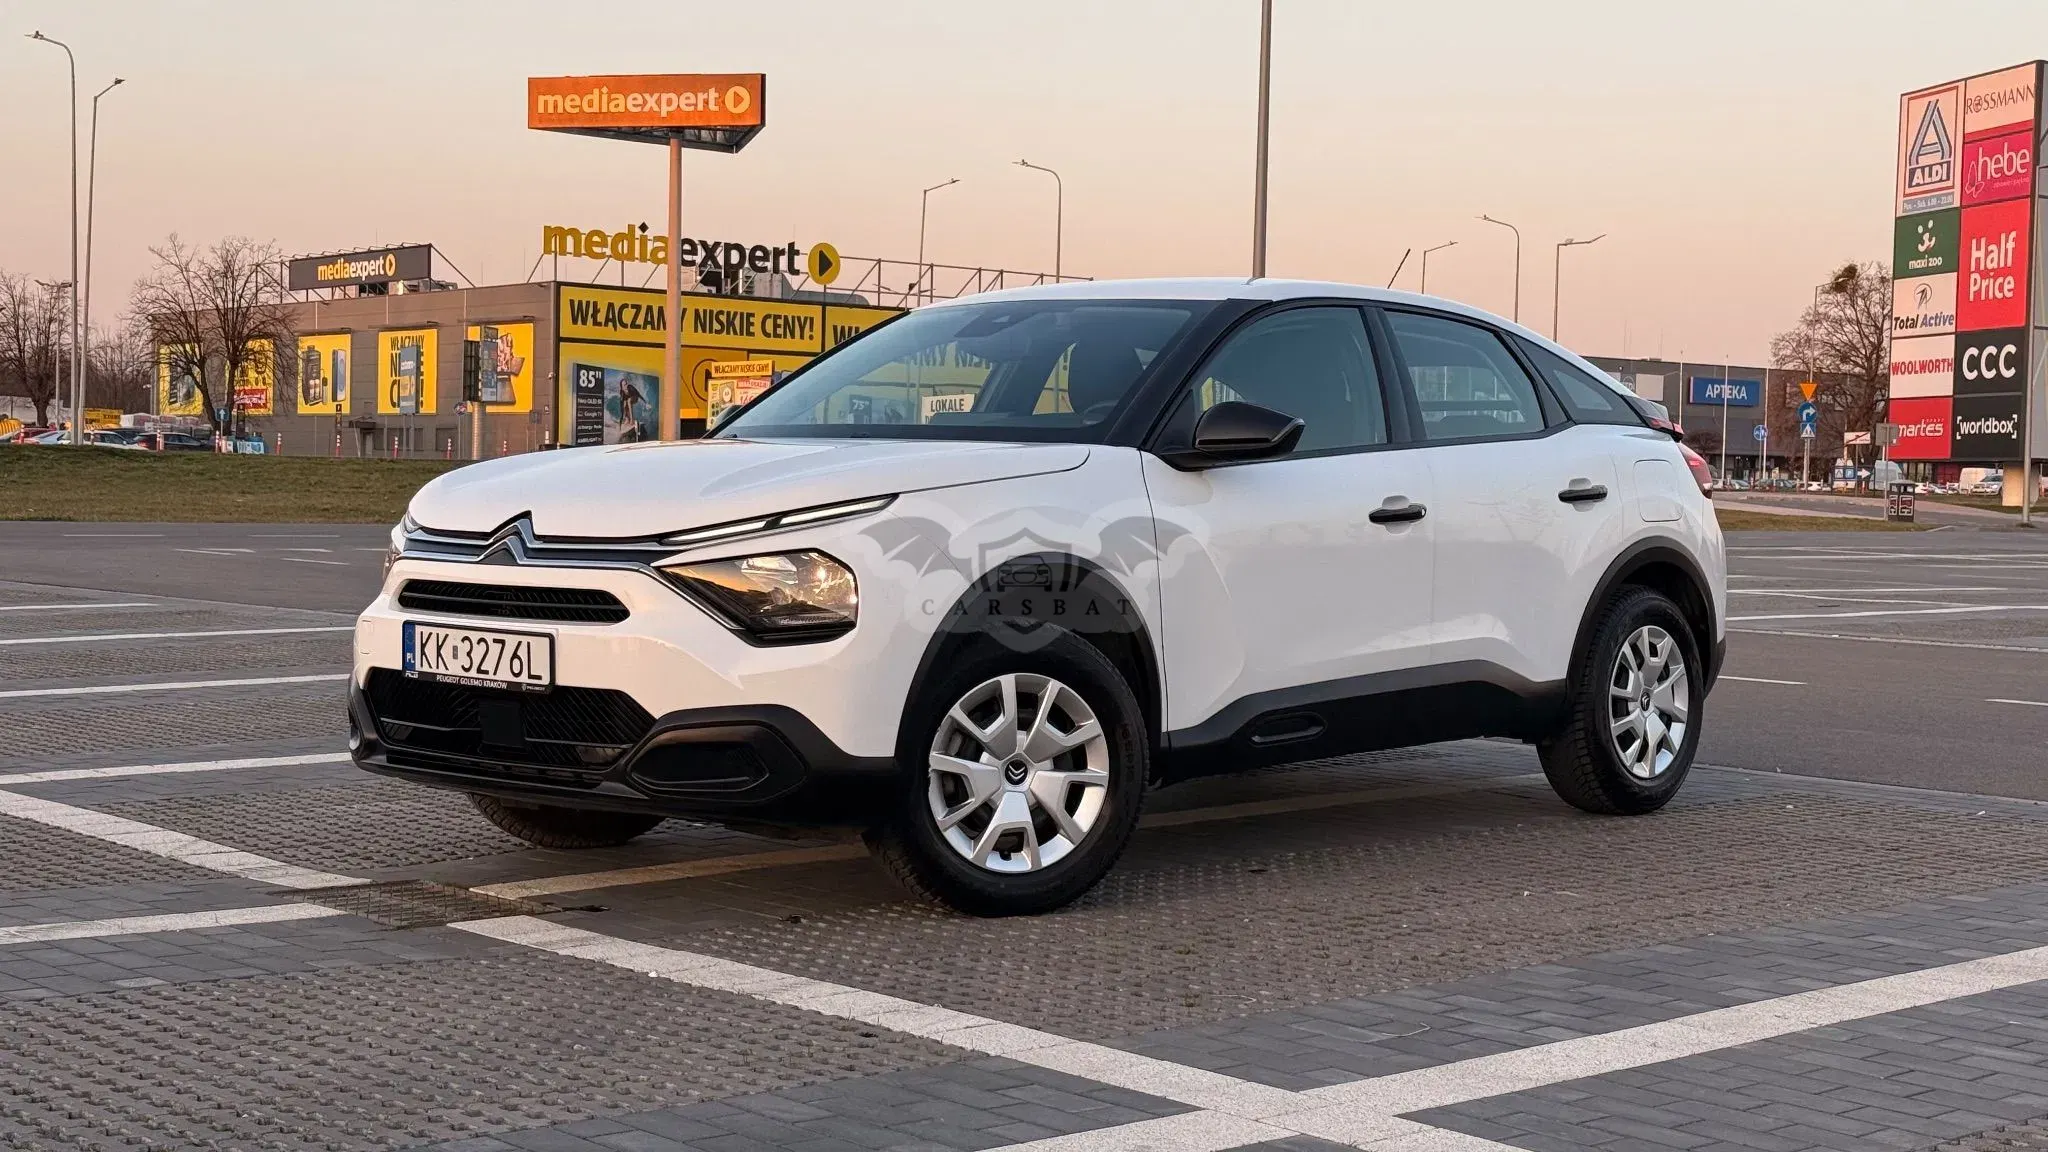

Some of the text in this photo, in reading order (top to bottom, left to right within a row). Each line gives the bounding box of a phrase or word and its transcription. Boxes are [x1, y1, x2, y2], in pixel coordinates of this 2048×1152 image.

[537, 85, 720, 117] mediaexpert
[1966, 84, 2034, 115] ROSSMANN
[1911, 163, 1949, 187] ALDI
[1977, 141, 2031, 182] hebe
[543, 221, 801, 279] mediaexpert
[1908, 254, 1943, 270] maxi zoo
[1970, 230, 2017, 272] Half
[317, 254, 386, 282] mediaexpert
[1969, 271, 2015, 302] Price
[693, 308, 755, 338] NISKIE
[760, 313, 815, 341] CENY!
[1893, 311, 1955, 331] Total Active
[1891, 357, 1954, 375] WOOLWORTH
[1962, 344, 2018, 381] CCC
[930, 398, 965, 412] LOKALE
[1705, 383, 1748, 400] APTEKA
[406, 652, 415, 664] PL
[420, 630, 543, 681] KK 3276L
[436, 674, 459, 684] PEUGEOT
